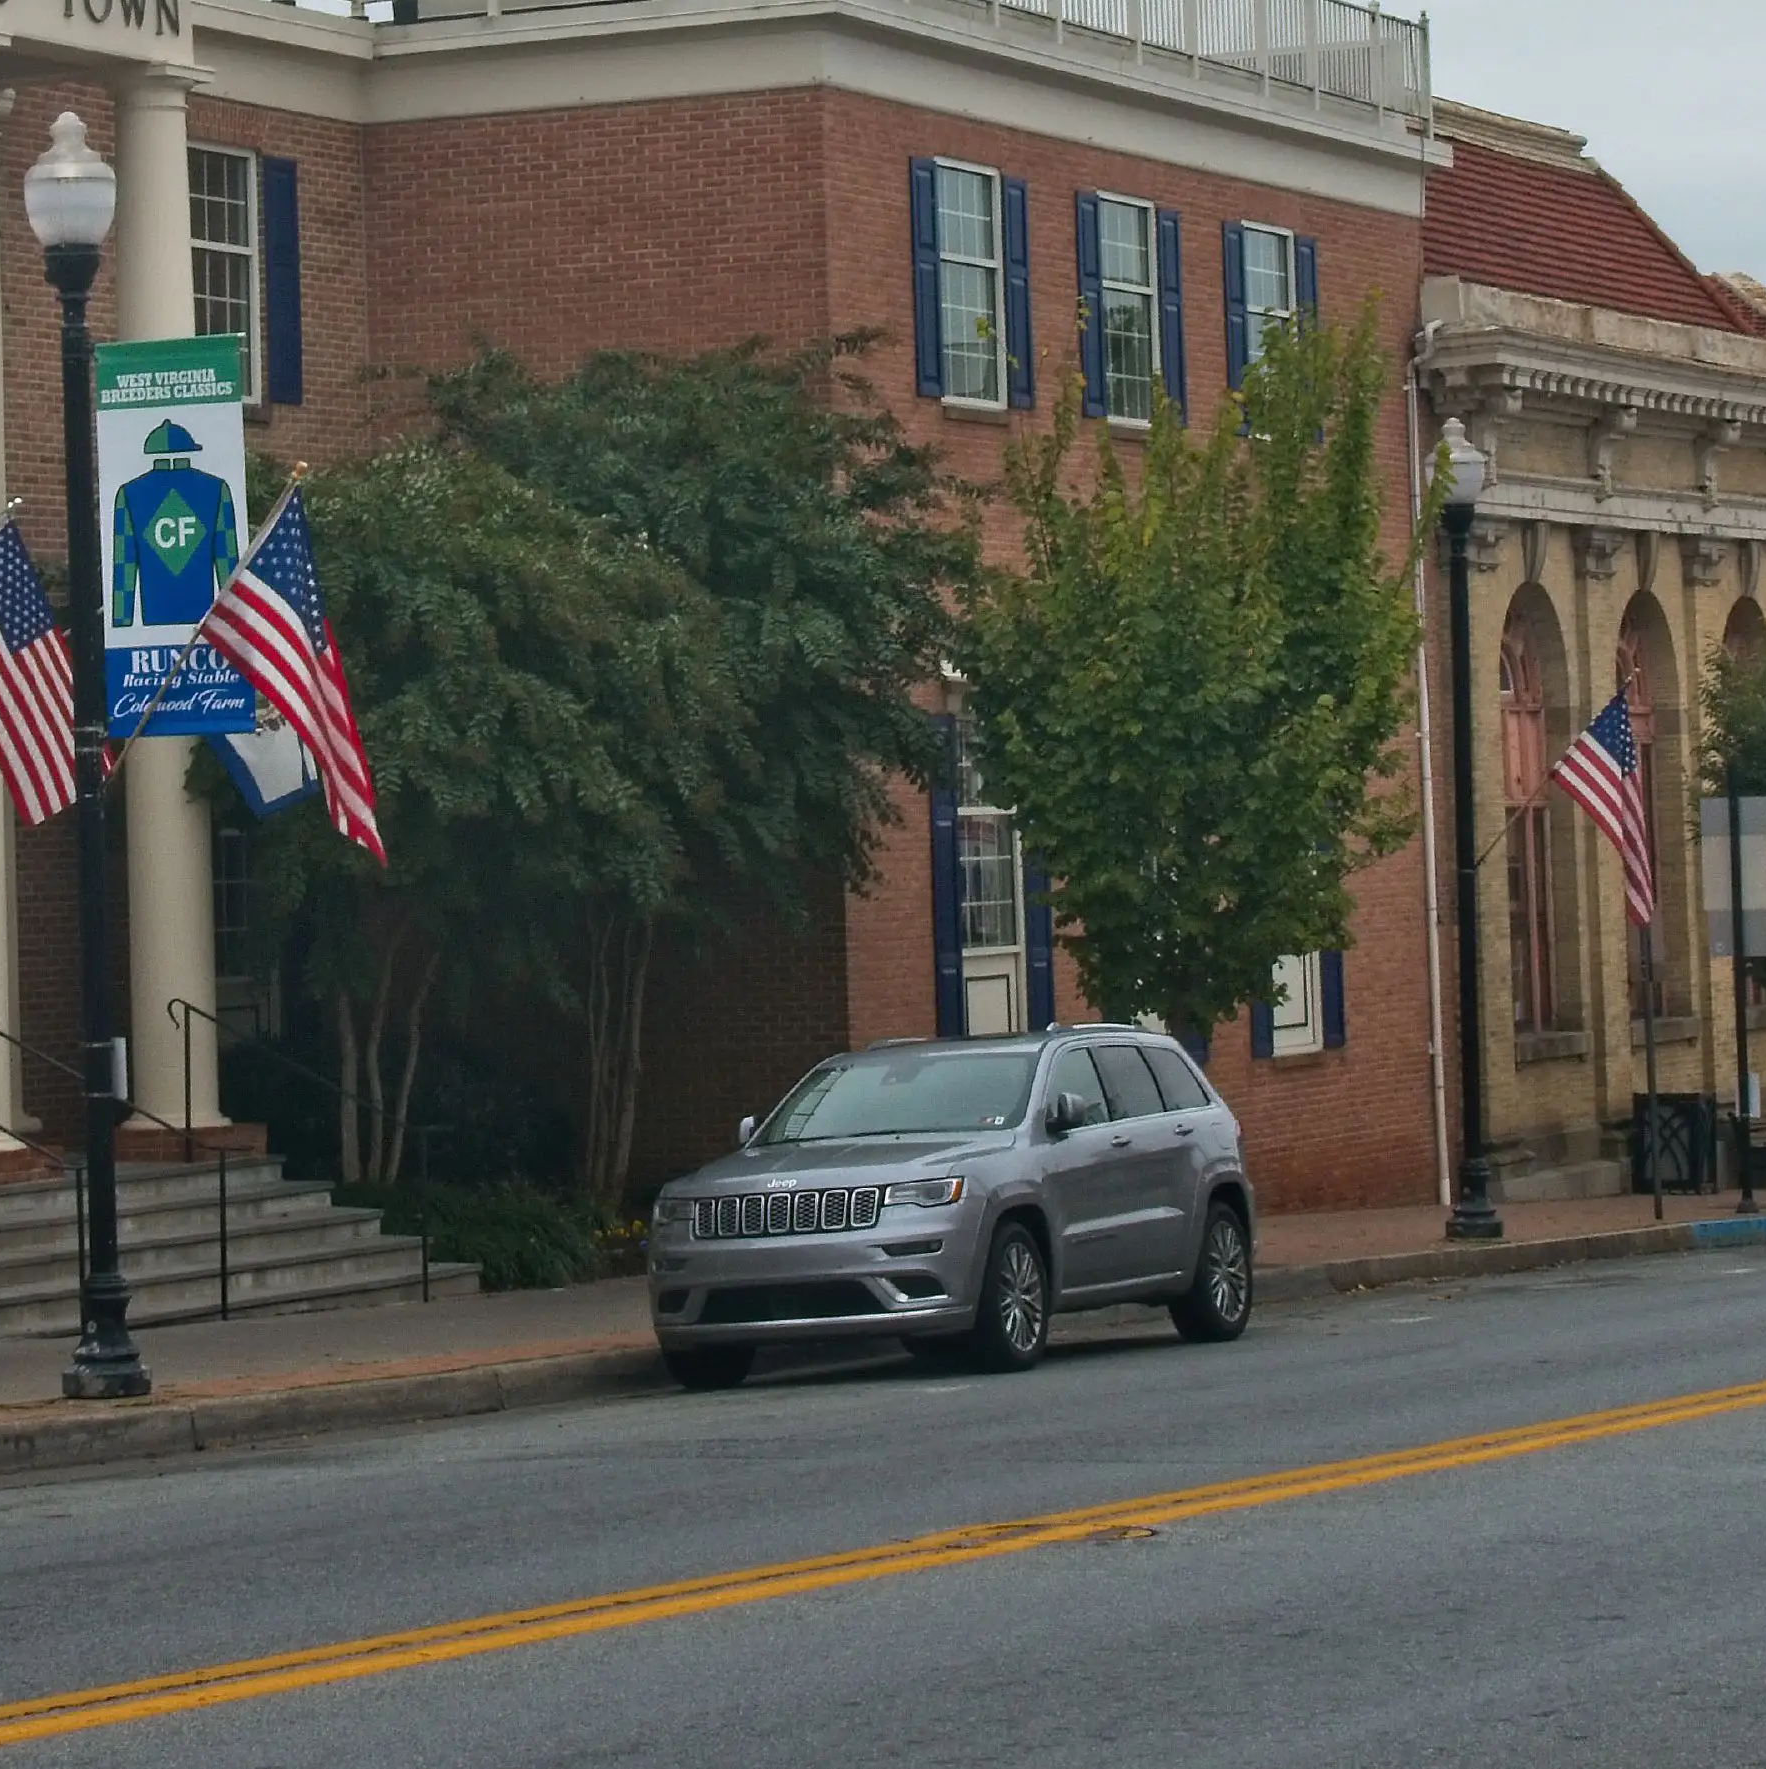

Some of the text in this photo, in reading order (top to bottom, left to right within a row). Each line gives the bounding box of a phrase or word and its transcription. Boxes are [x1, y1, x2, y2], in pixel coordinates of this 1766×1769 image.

[116, 368, 215, 388] WEST VIRGINIA
[101, 386, 171, 403] BREEDERS
[155, 516, 196, 548] CF
[187, 670, 240, 684] Stable
[197, 689, 245, 714] Farm
[767, 1178, 797, 1188] Jeep
